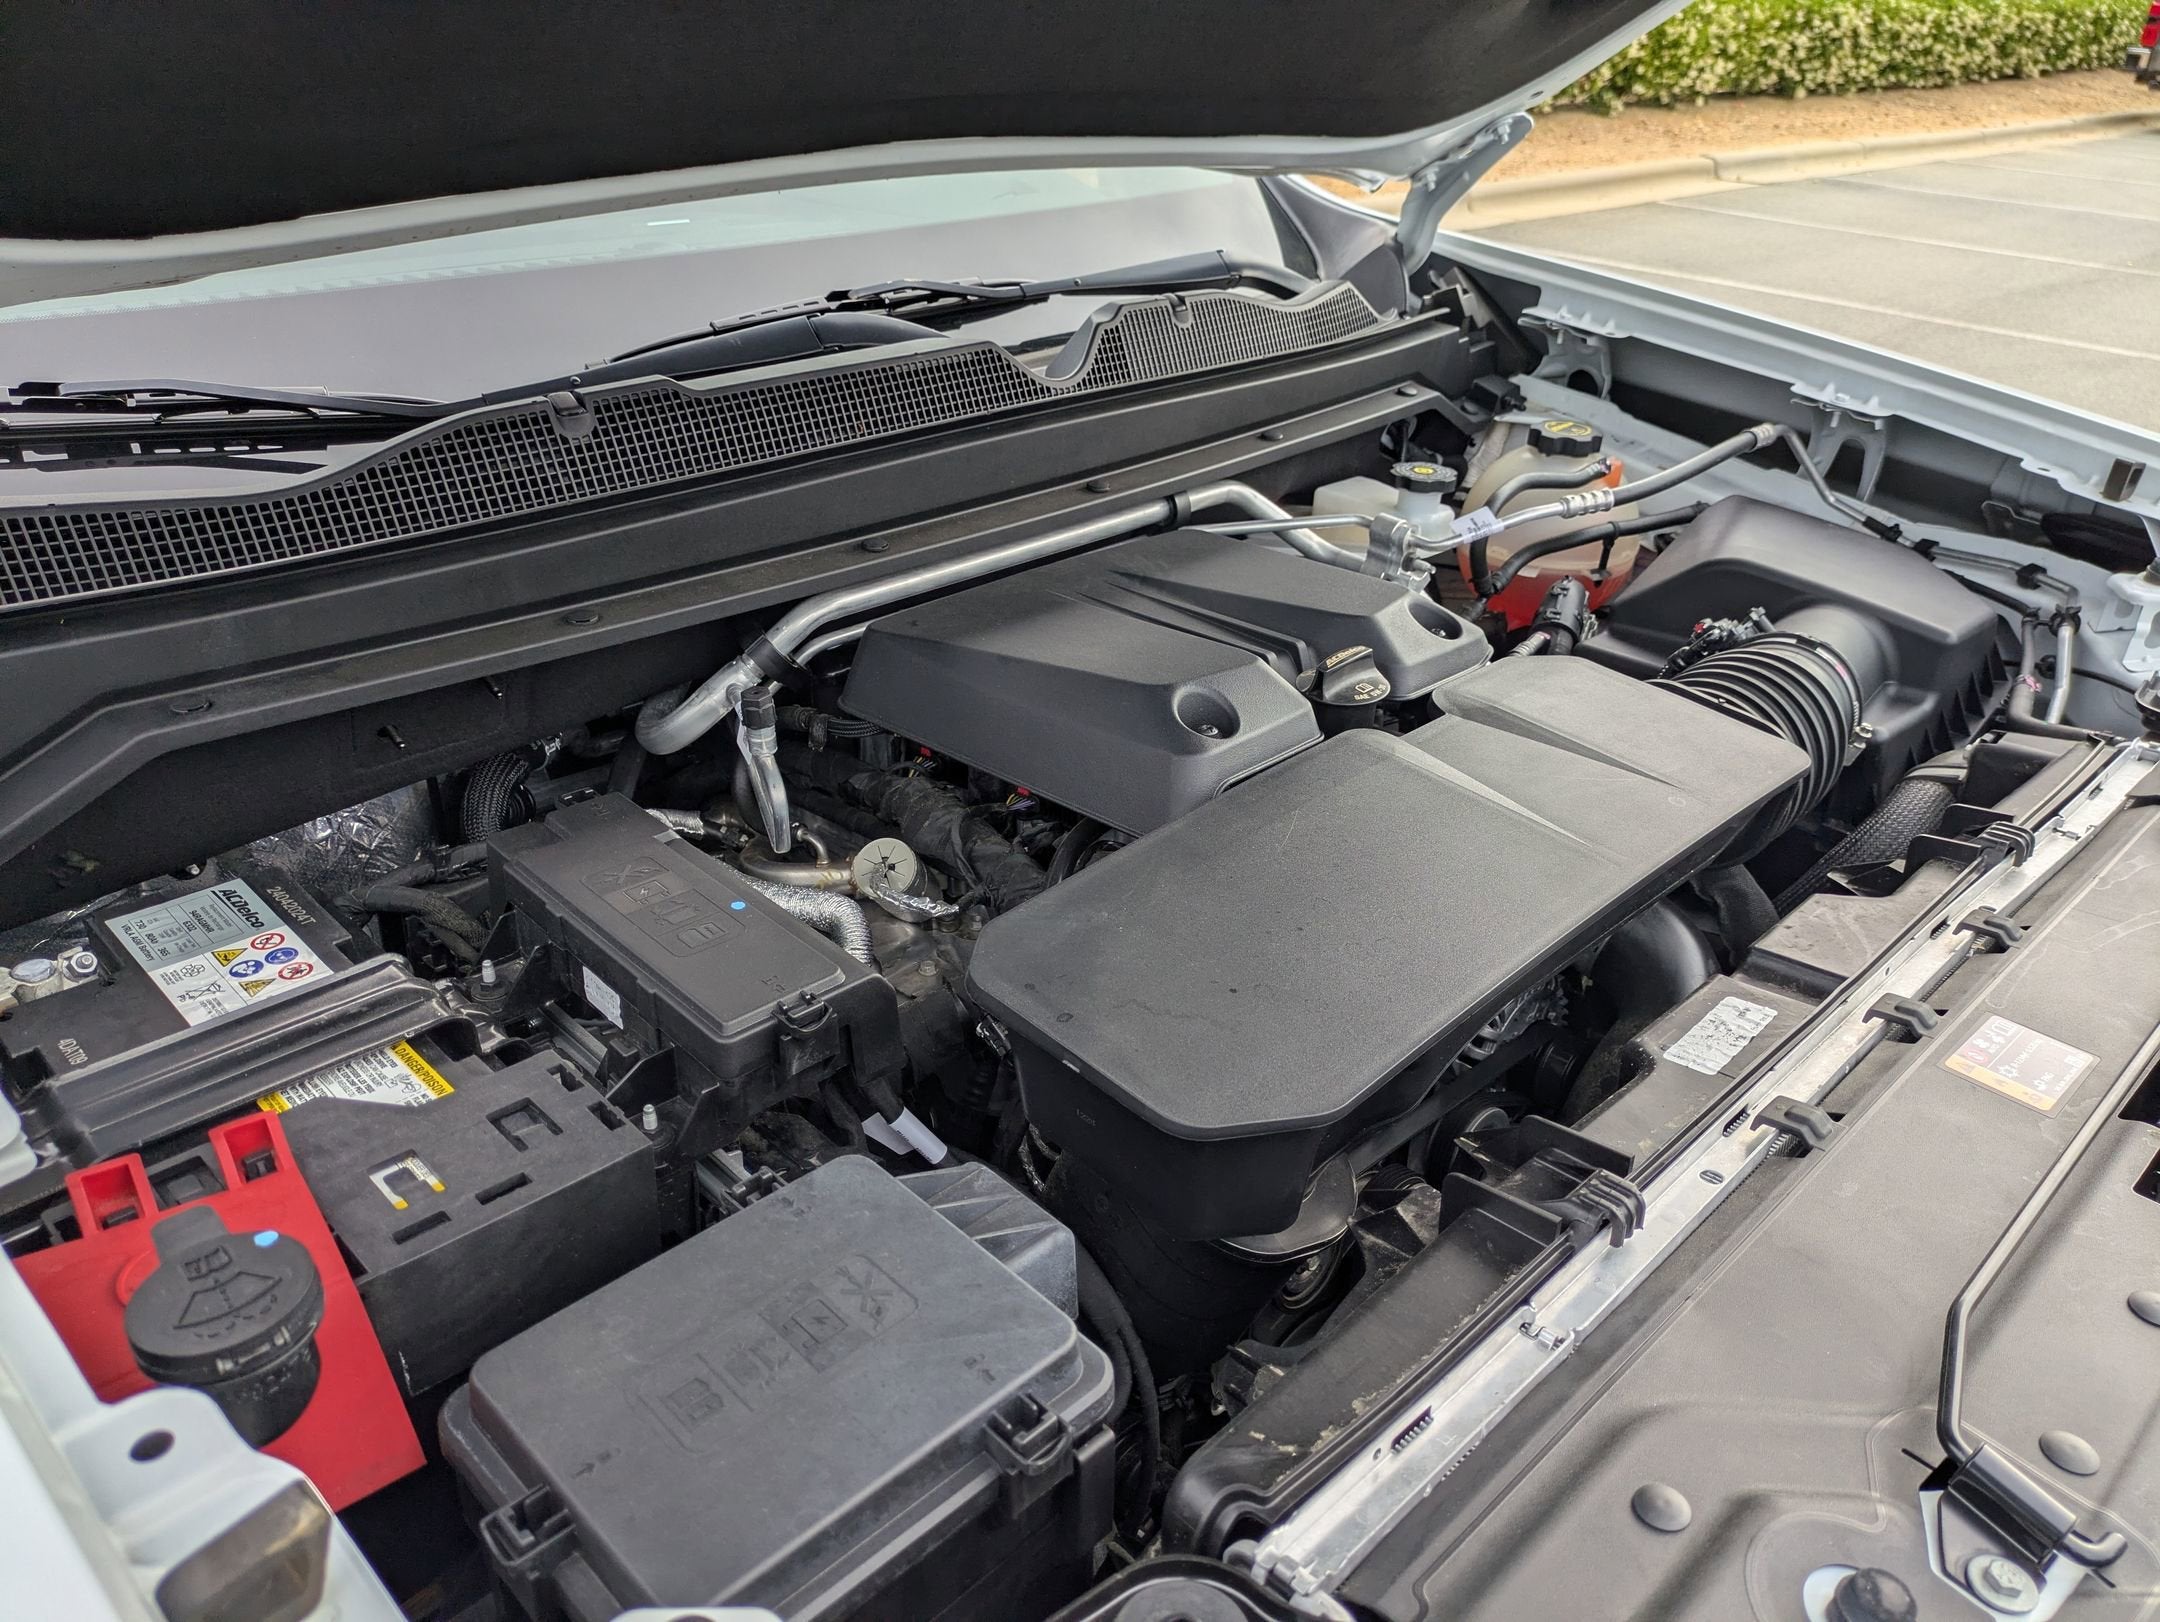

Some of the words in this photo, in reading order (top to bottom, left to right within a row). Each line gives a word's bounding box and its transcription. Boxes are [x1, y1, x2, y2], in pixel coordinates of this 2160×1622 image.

[135, 920, 147, 930] 730
[218, 889, 264, 928] ACDelco
[266, 886, 317, 925] 24042024T
[121, 924, 133, 937] VRLA
[131, 936, 143, 947] AGM
[138, 944, 155, 962] Battery
[395, 1047, 448, 1096] DANGER/POISON
